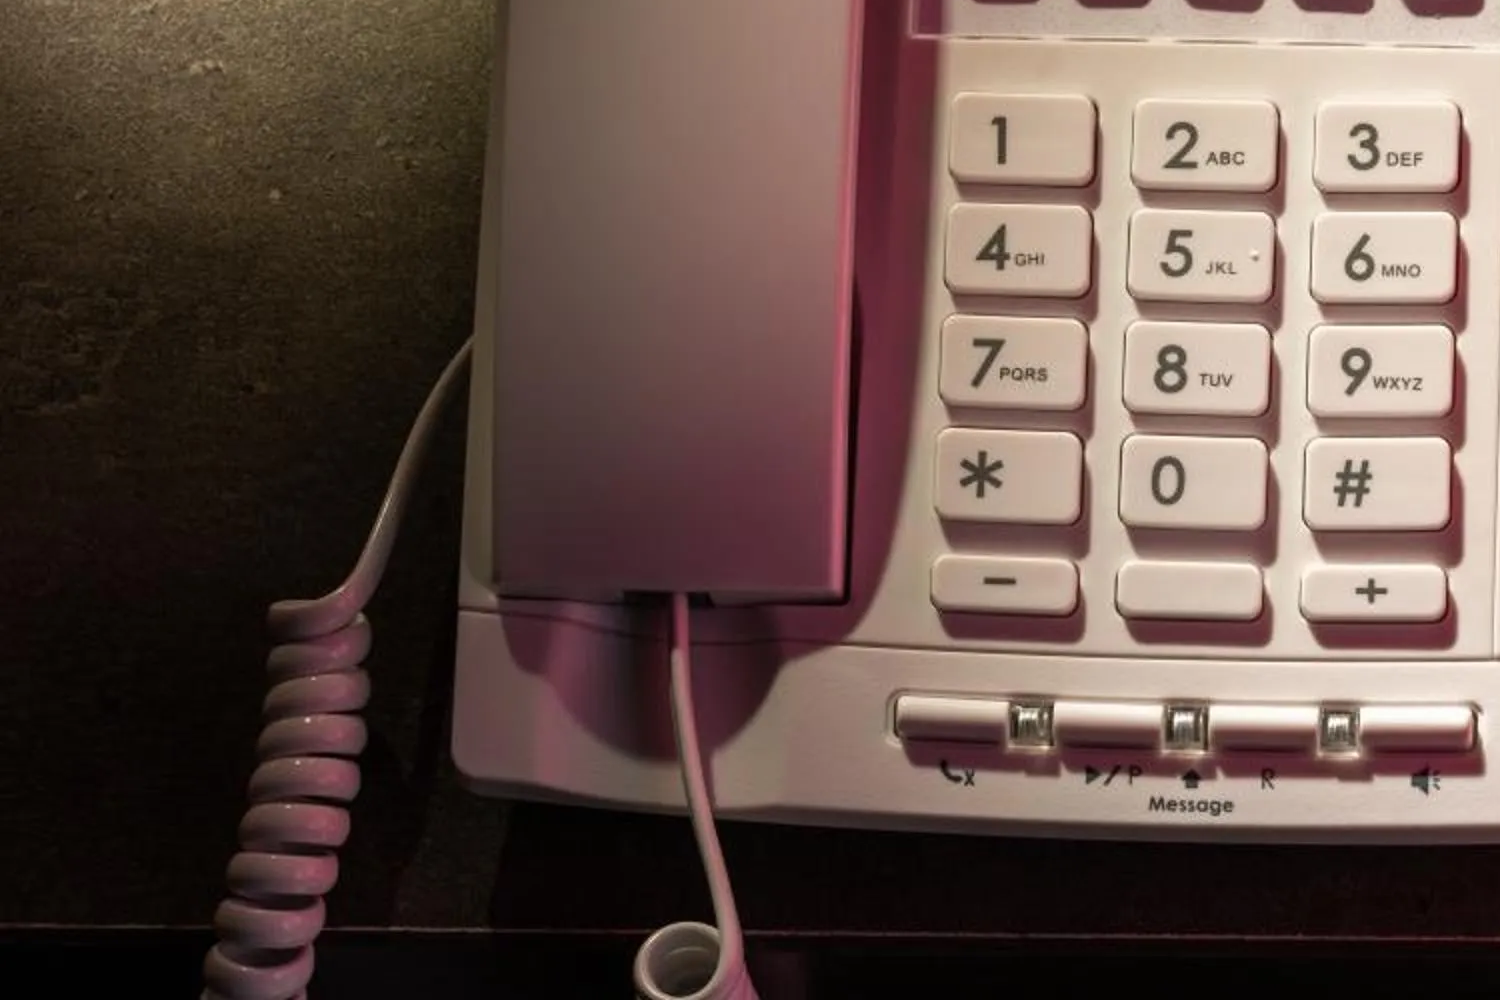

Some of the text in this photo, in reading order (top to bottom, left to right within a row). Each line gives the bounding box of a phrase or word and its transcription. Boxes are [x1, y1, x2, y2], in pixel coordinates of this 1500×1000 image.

[991, 116, 1008, 165] 1
[1163, 121, 1246, 169] 2 ABC
[1347, 123, 1424, 170] 3 DEF
[975, 224, 1045, 270] 4 GHI
[1159, 229, 1238, 277] 5 JKL
[1344, 233, 1421, 281] 6 MNO
[971, 338, 1048, 387] 7 PQRS
[1153, 344, 1234, 393] 8 TUV
[1340, 347, 1423, 396] 9 WXYZ
[1151, 456, 1186, 505] 0
[1261, 768, 1276, 790] R
[1149, 796, 1235, 816] Message
